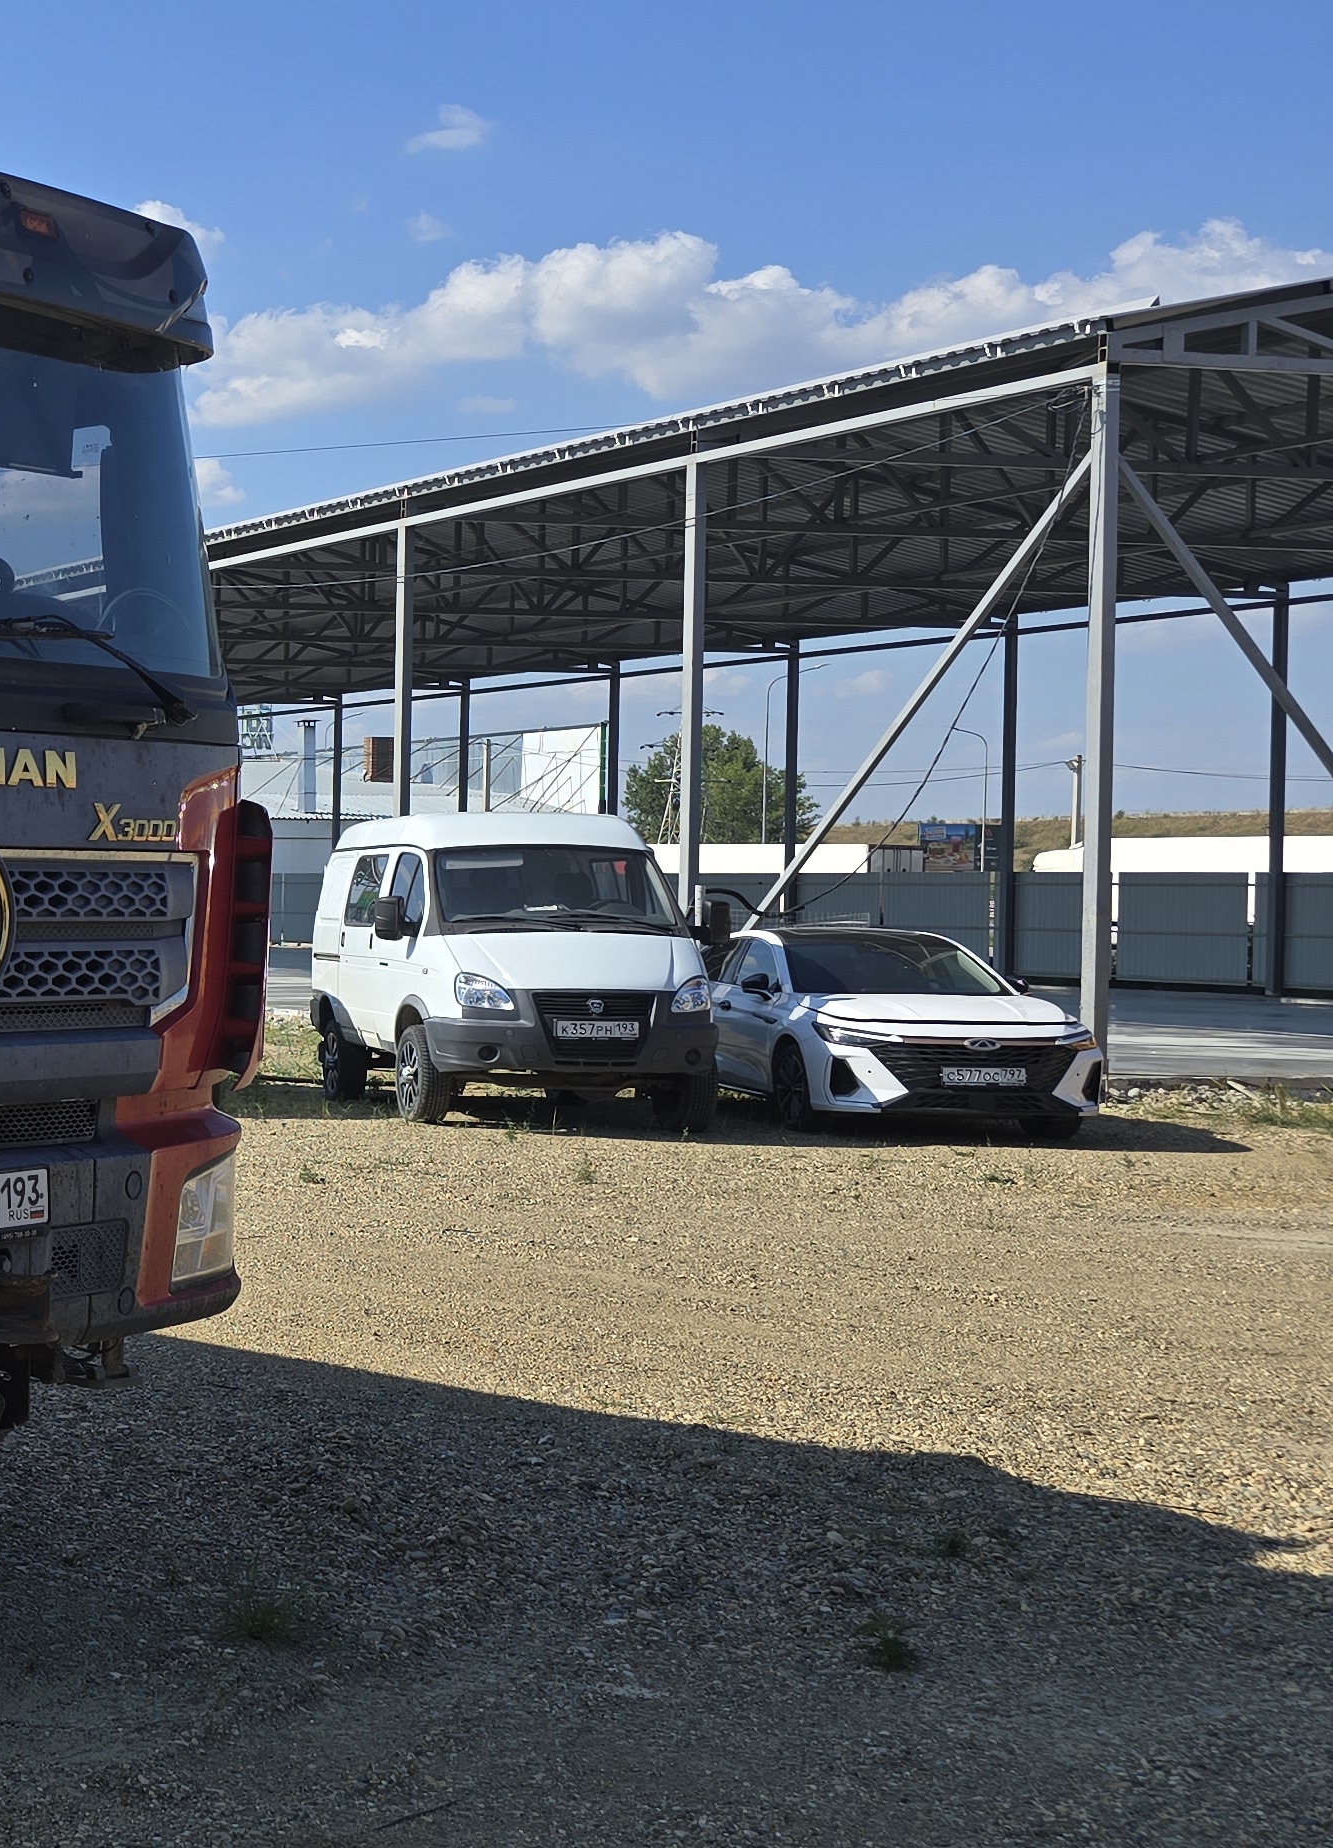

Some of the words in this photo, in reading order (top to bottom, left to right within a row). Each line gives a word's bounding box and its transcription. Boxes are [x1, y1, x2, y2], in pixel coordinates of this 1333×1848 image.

[88, 802, 177, 842] X3000
[615, 1022, 635, 1033] 193
[1001, 1069, 1022, 1079] 797
[0, 1174, 40, 1210] 193
[8, 1208, 30, 1222] RUS
